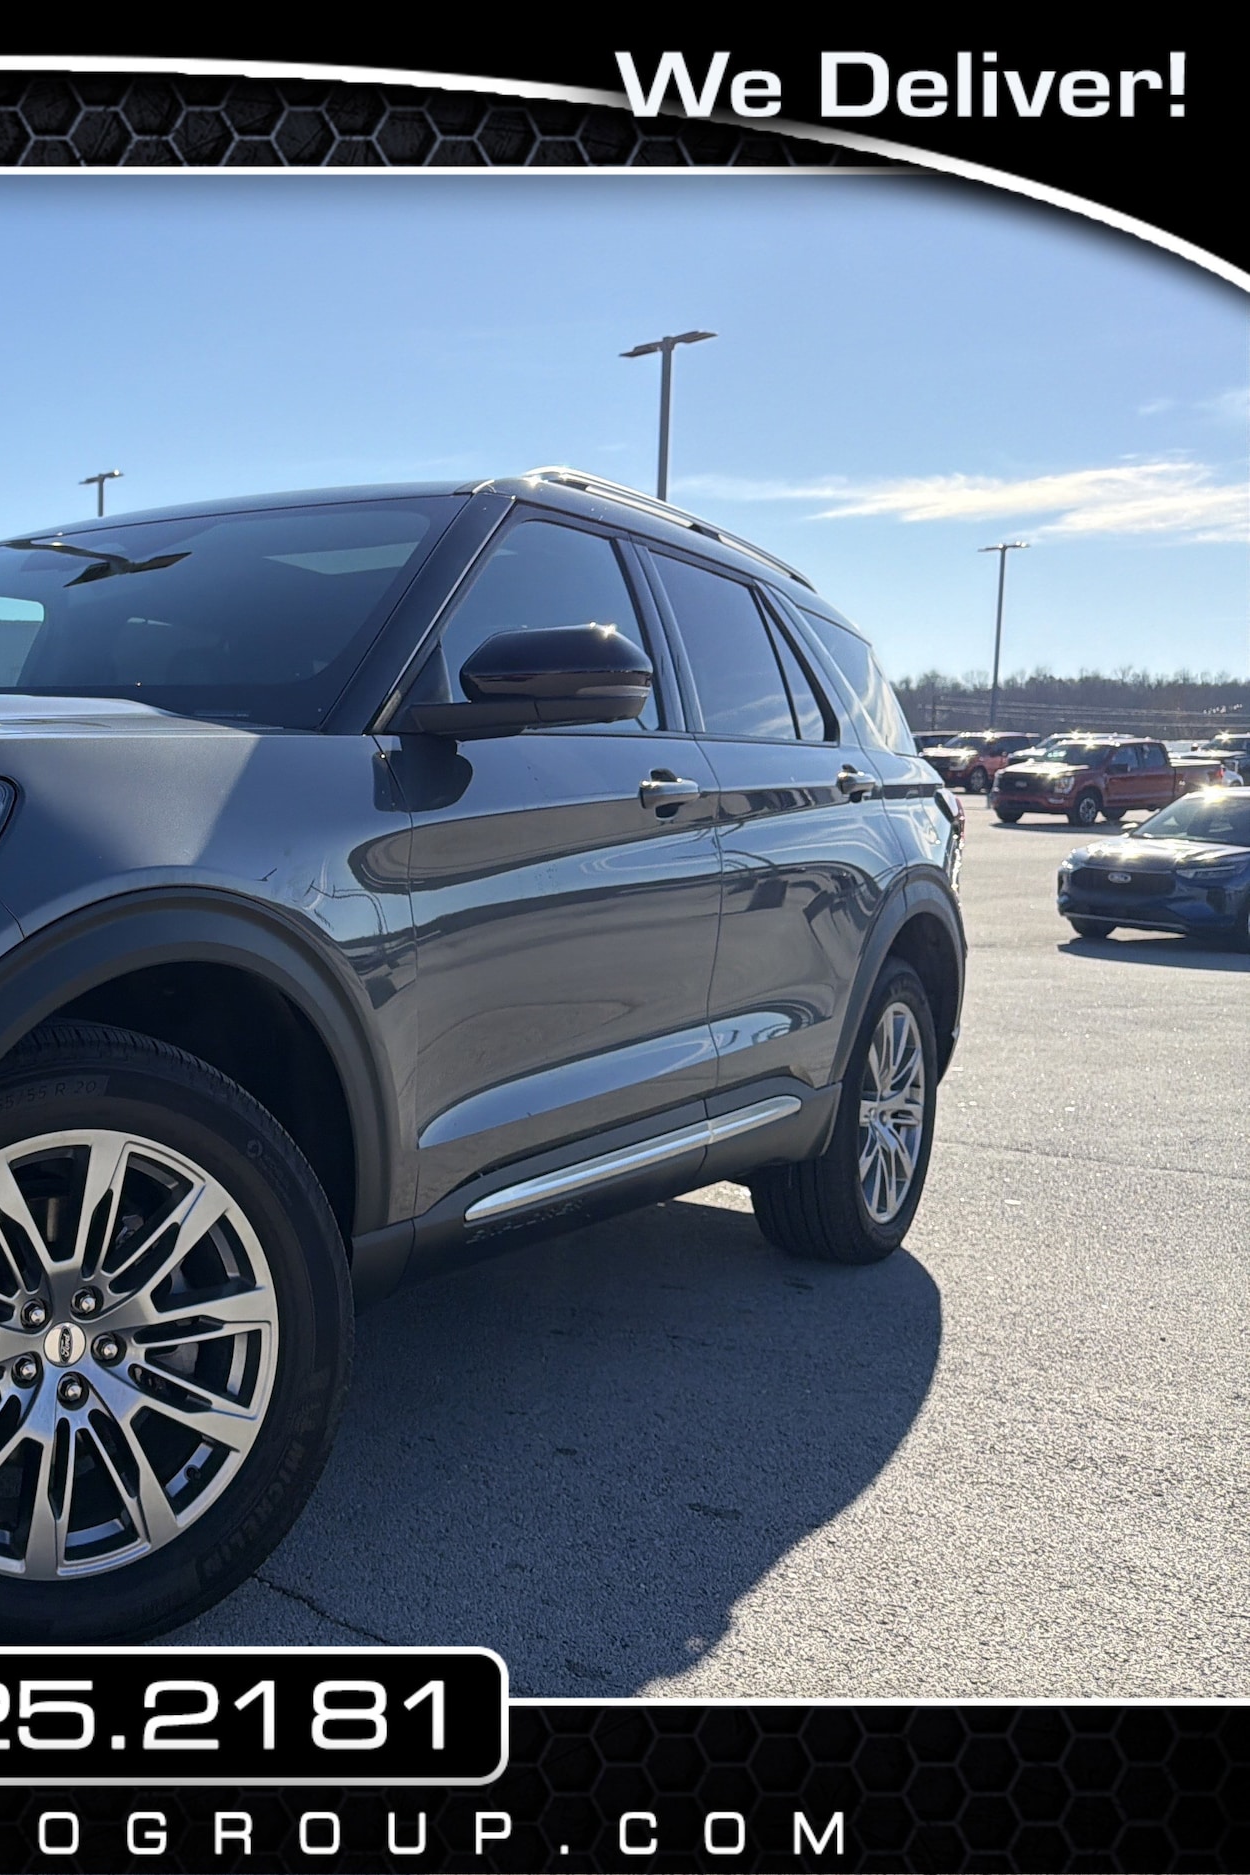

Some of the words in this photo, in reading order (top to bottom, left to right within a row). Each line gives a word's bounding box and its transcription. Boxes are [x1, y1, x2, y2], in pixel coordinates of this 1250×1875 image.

[54, 1082, 67, 1097] R
[73, 1079, 97, 1095] 20
[203, 1439, 306, 1578] MICHELIN
